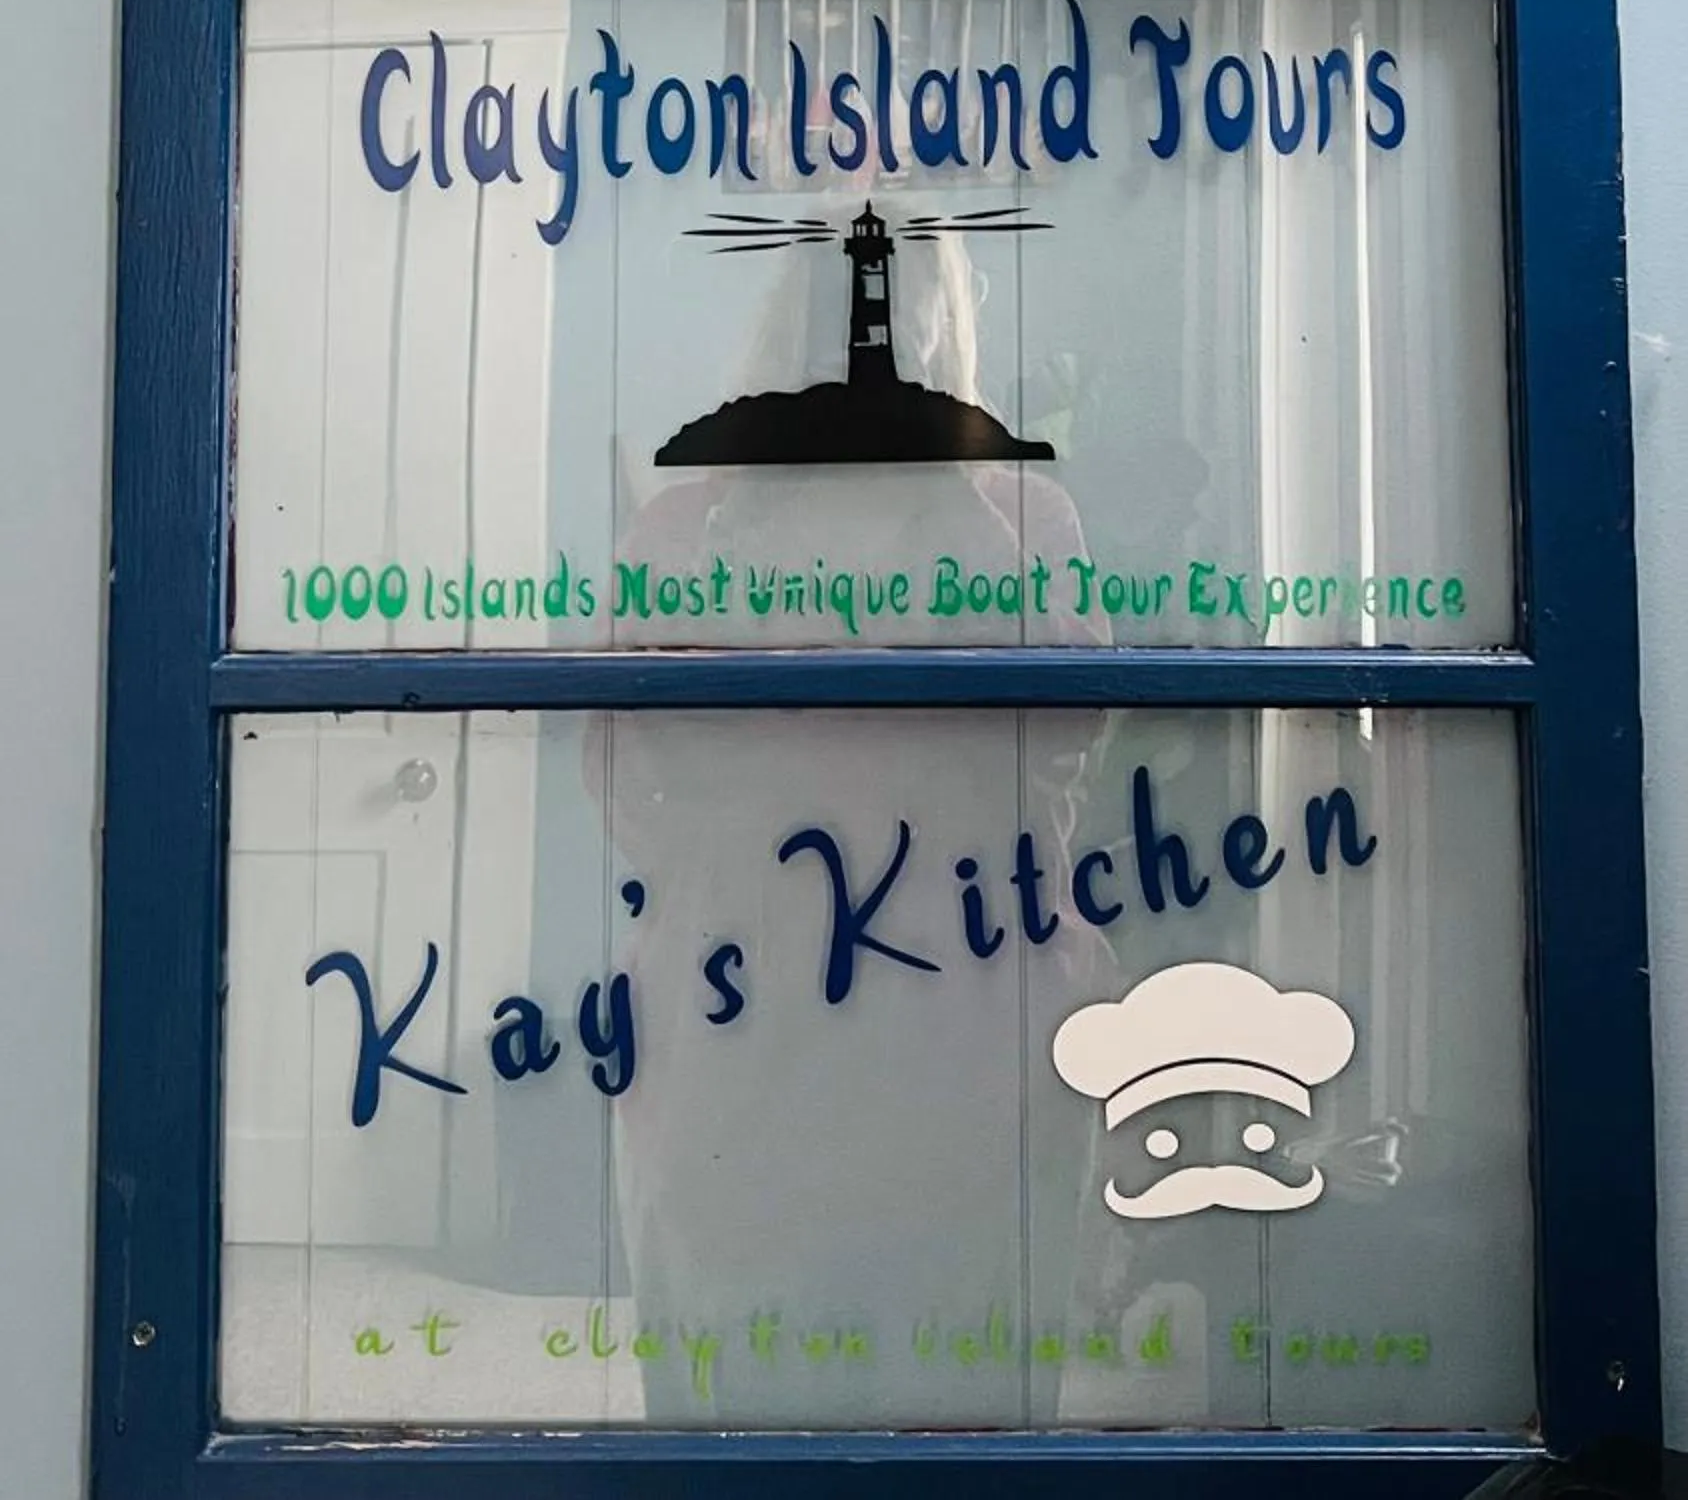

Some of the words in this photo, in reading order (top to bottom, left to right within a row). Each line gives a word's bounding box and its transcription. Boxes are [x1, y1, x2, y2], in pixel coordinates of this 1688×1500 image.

[359, 29, 758, 246] Clayton
[1129, 13, 1407, 160] Tours
[282, 563, 408, 623] 1000
[425, 550, 596, 622] Islands
[611, 555, 733, 620] Most
[748, 557, 911, 636] Unique
[927, 554, 1052, 618] Boat
[1066, 555, 1173, 619] Tour
[304, 877, 746, 1128] Kay's
[777, 765, 1379, 1006] Kitchen
[354, 1312, 463, 1358] at
